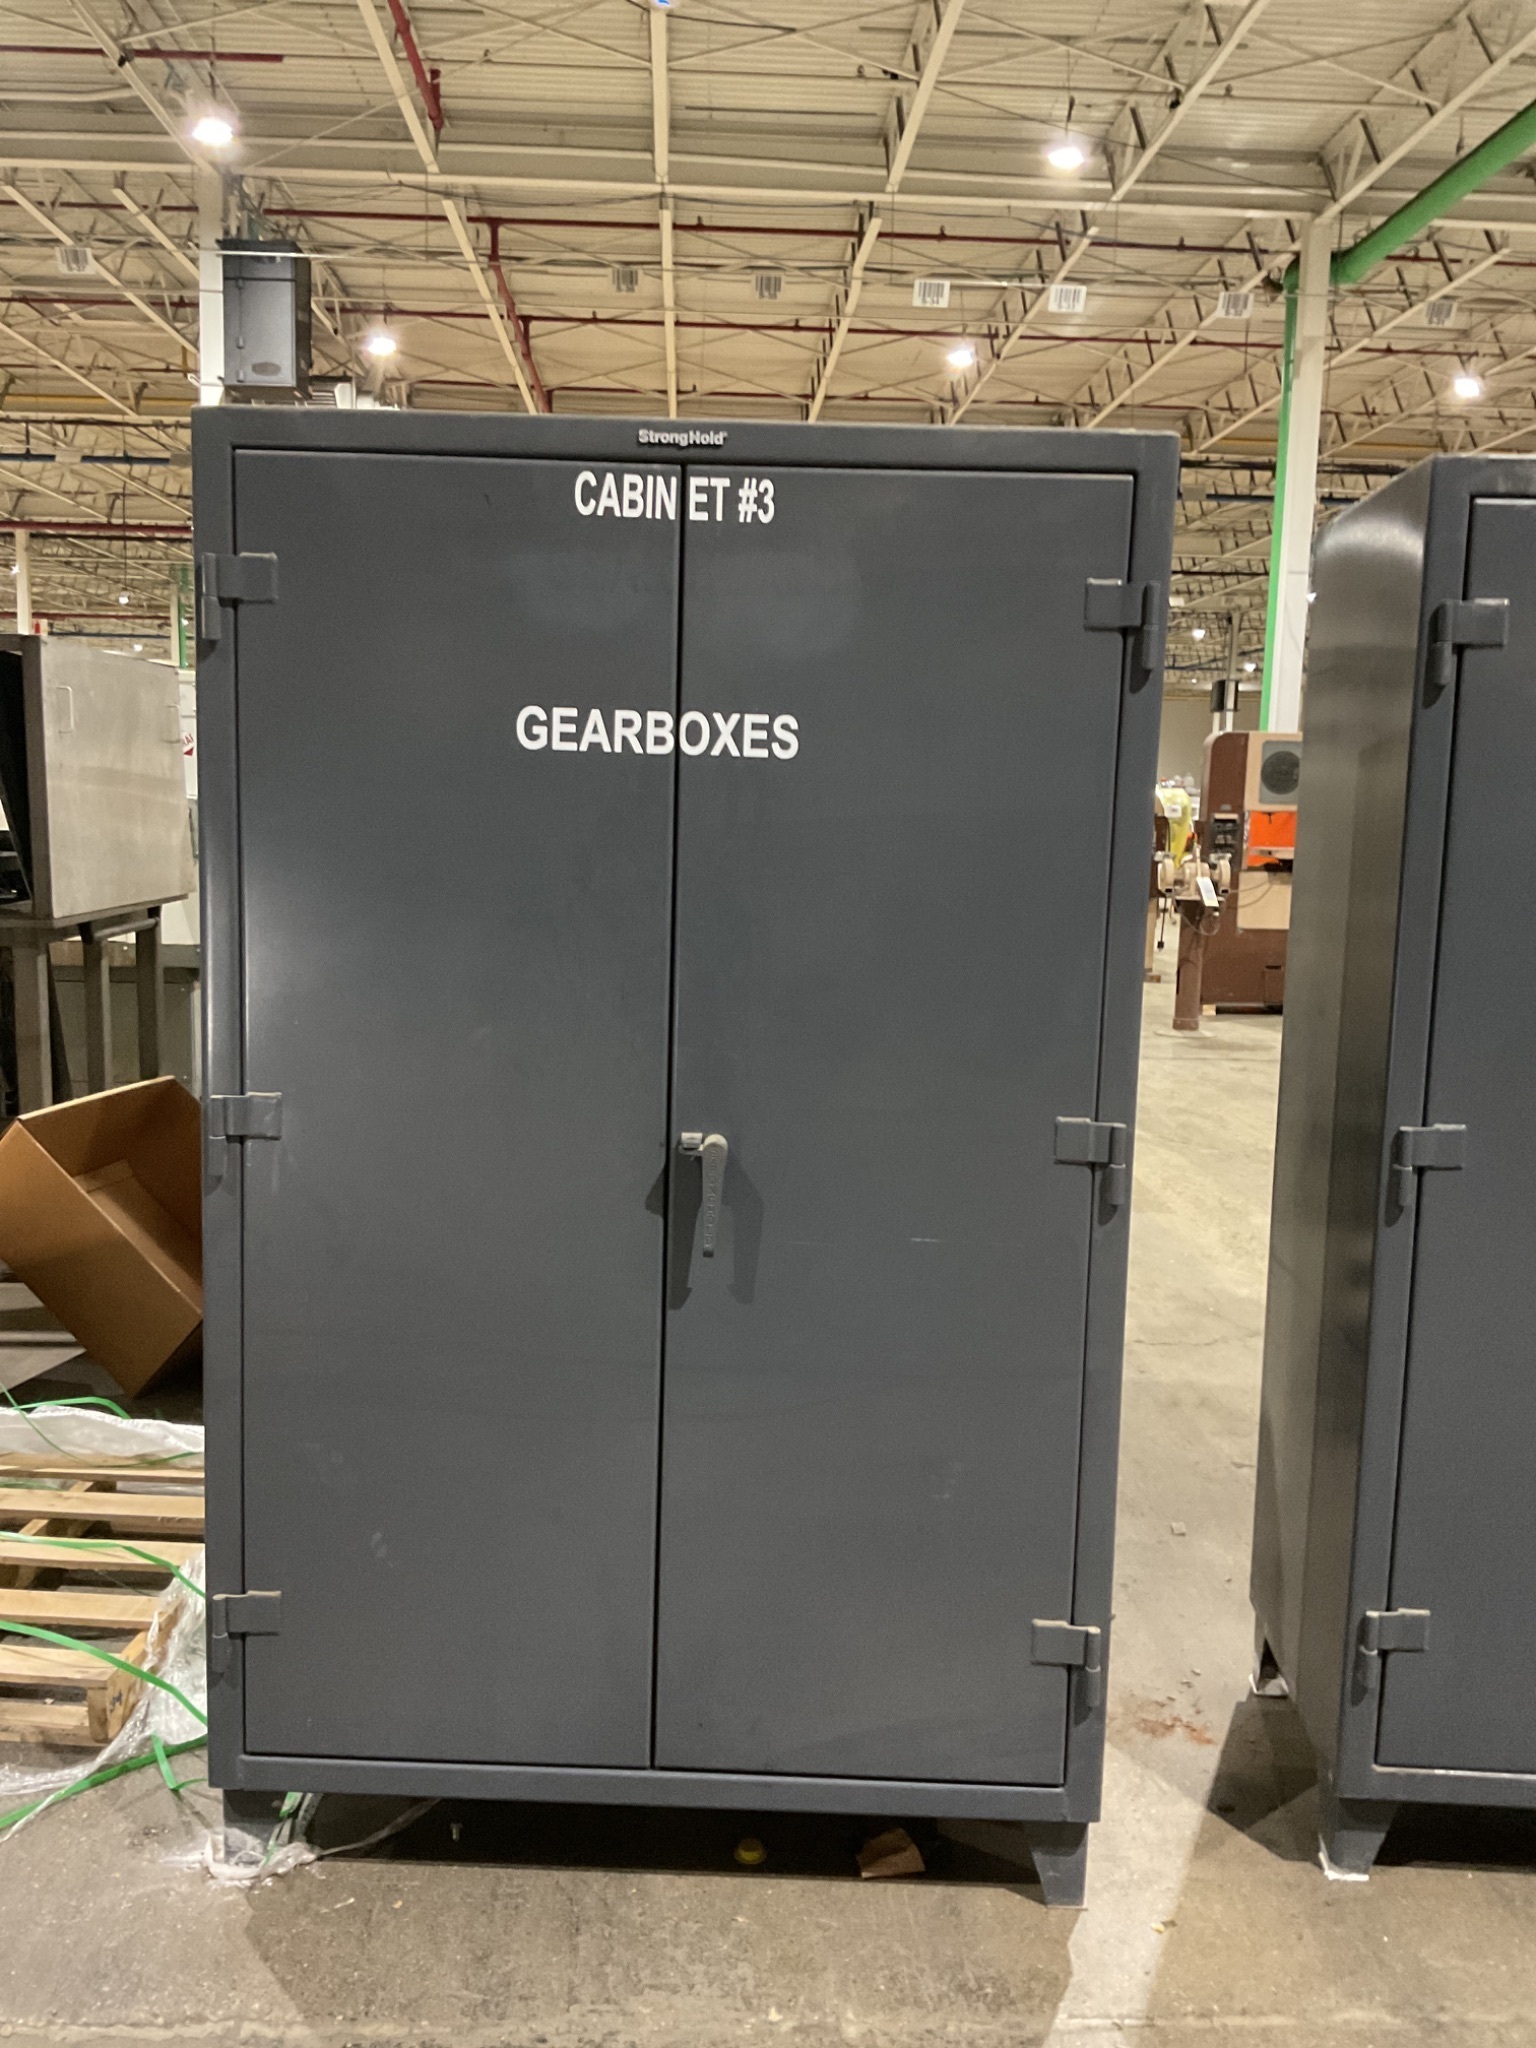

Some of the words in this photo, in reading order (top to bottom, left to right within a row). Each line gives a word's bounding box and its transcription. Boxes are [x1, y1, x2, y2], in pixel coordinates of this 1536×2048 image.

[574, 470, 731, 521] CABINET
[738, 477, 775, 524] #3
[516, 705, 799, 760] GEARBOXES
